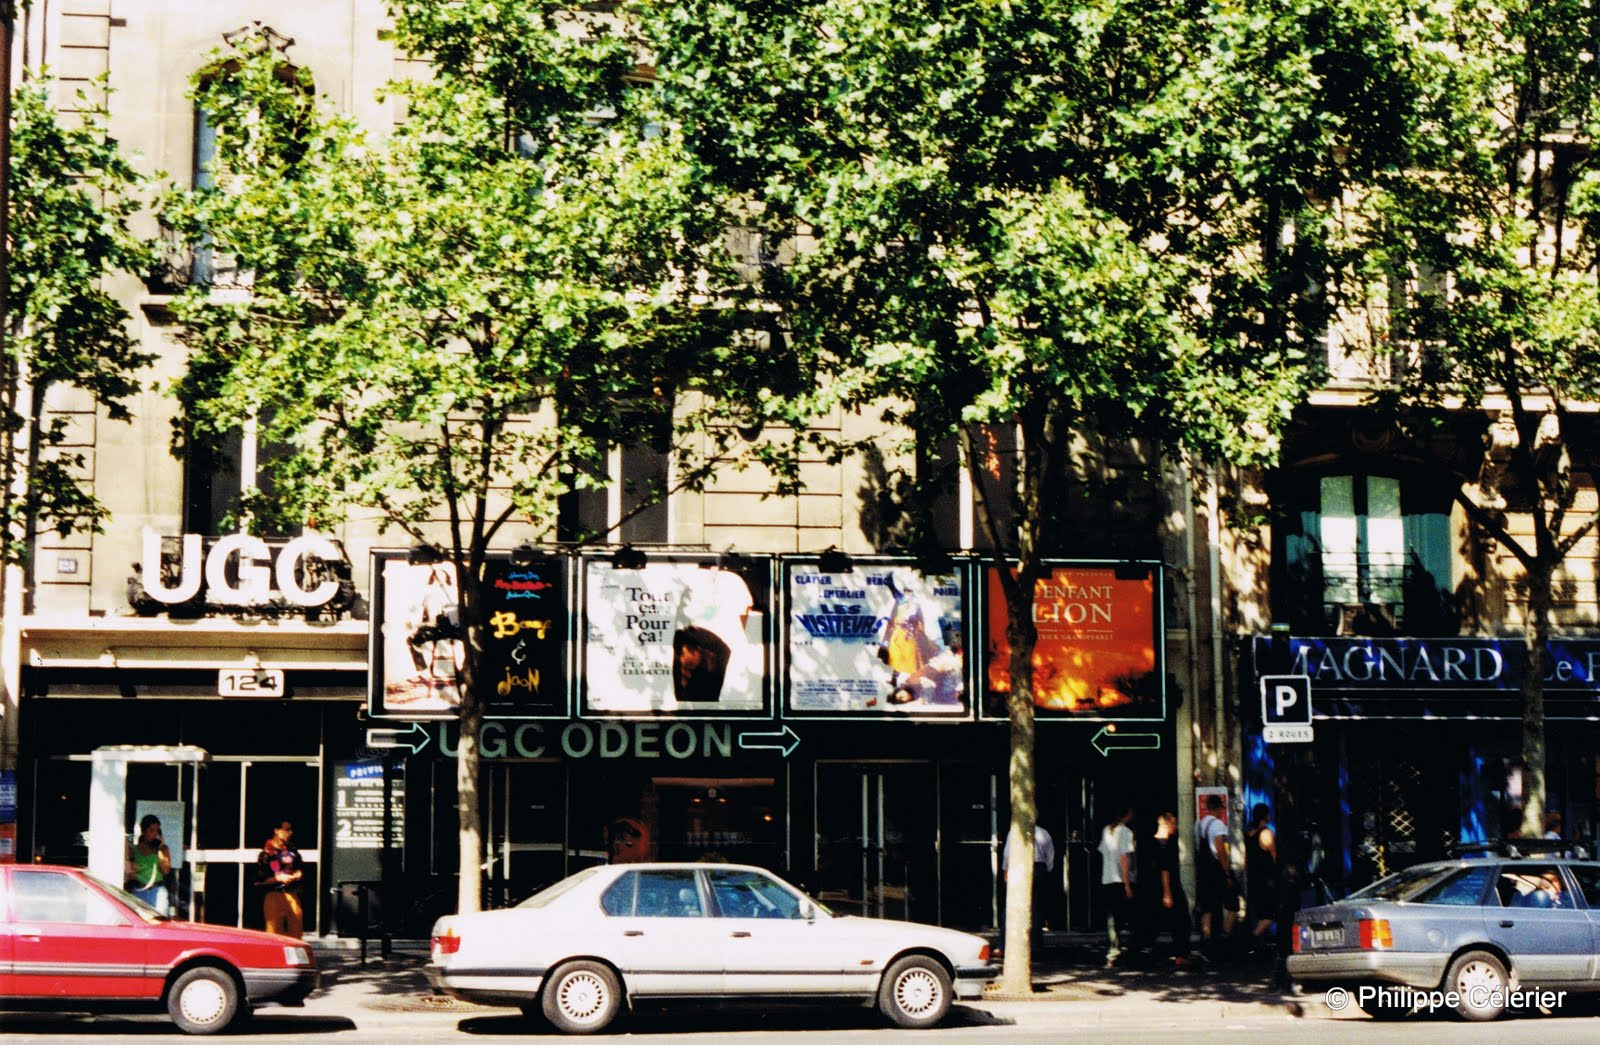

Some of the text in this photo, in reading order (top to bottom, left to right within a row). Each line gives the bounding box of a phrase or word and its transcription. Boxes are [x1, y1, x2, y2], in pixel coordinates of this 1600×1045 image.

[143, 531, 341, 607] UGC
[819, 588, 866, 599] EMERCIER
[1034, 585, 1114, 599] ENFANT
[820, 604, 862, 614] LES
[1032, 602, 1113, 624] LION
[626, 614, 670, 631] Pour
[225, 675, 278, 691] 124
[1275, 685, 1297, 716] P
[561, 721, 732, 759] ODEON
[337, 820, 351, 837] 2
